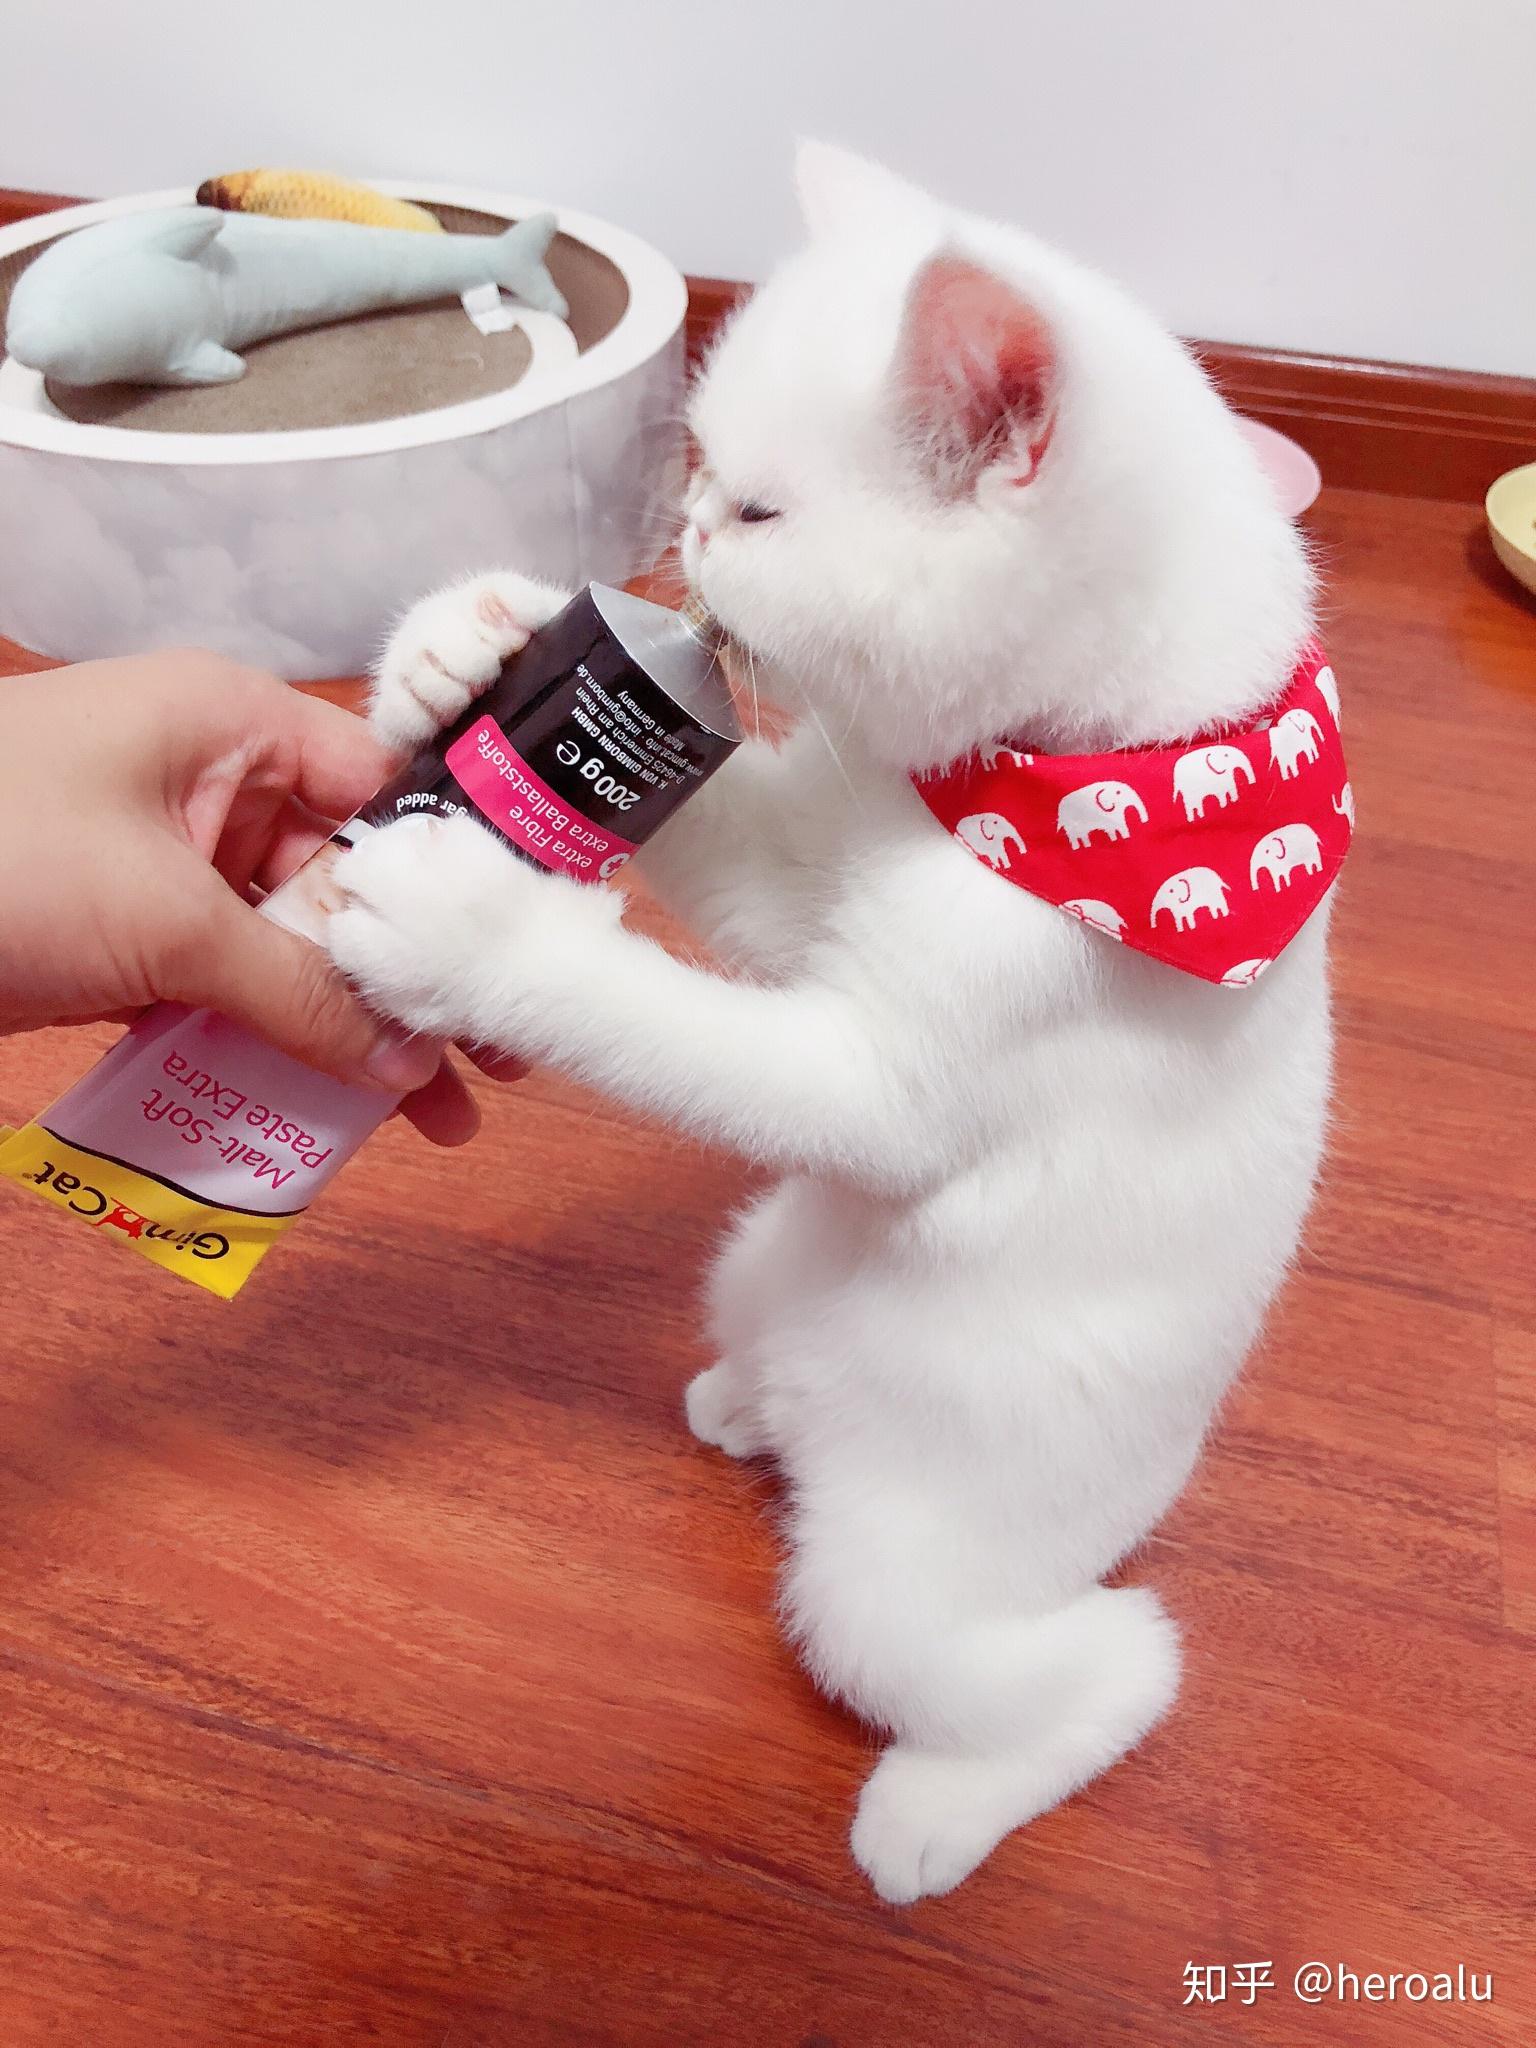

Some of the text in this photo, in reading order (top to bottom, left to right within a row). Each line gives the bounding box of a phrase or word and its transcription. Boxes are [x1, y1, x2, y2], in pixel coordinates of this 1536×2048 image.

[575, 687, 686, 784] D-46425 Emmerich am Rhein
[576, 664, 641, 736] info@gimborn.de
[616, 689, 686, 751] Made in Germany
[571, 707, 668, 790] H. VON GIMBORN GMBH
[396, 793, 468, 817] gar added
[475, 729, 609, 853] extra Ballaststoffe
[508, 804, 593, 869] extra Fibre
[137, 1088, 296, 1190] Malt-Soft
[161, 1050, 334, 1168] Paste Extra
